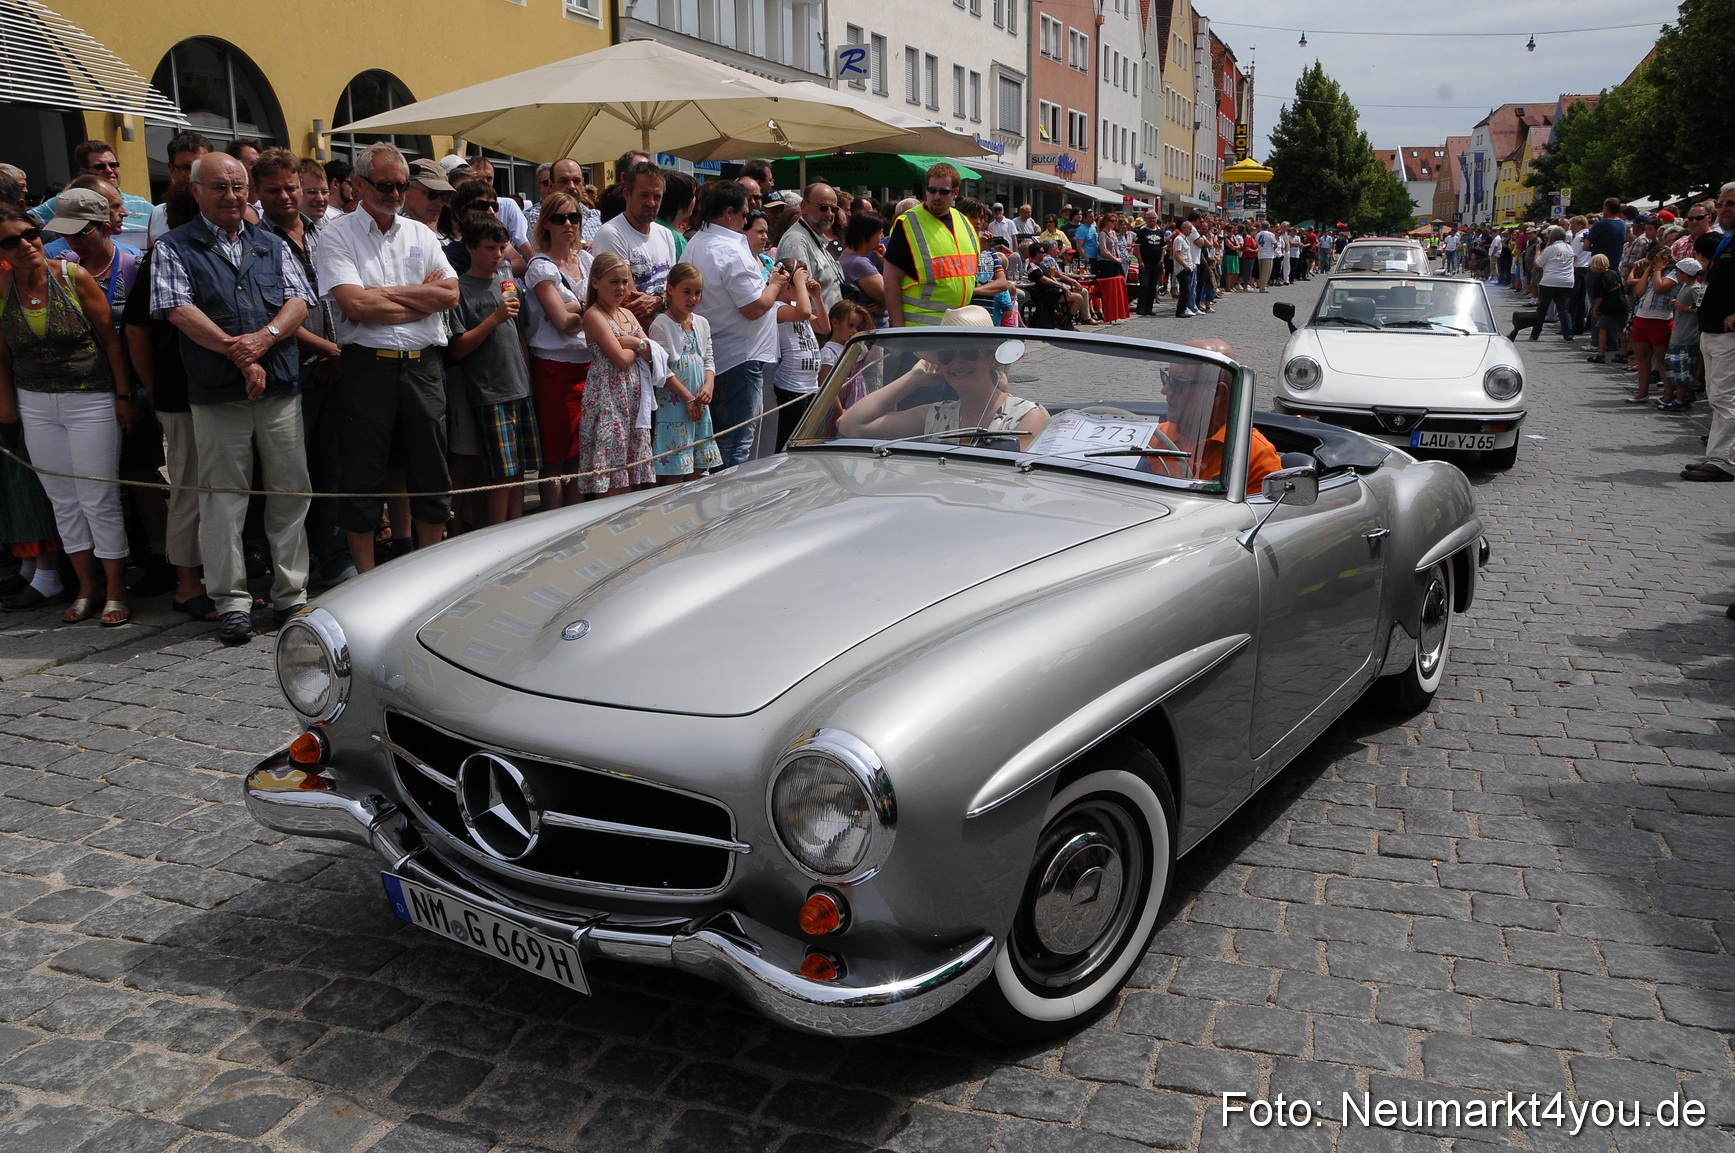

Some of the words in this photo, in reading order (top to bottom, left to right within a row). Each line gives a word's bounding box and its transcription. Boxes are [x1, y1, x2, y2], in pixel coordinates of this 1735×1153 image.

[606, 169, 614, 180] 24
[1088, 425, 1136, 443] 273
[1420, 433, 1448, 448] LAU
[409, 887, 451, 934] NM
[493, 922, 575, 984] 669H
